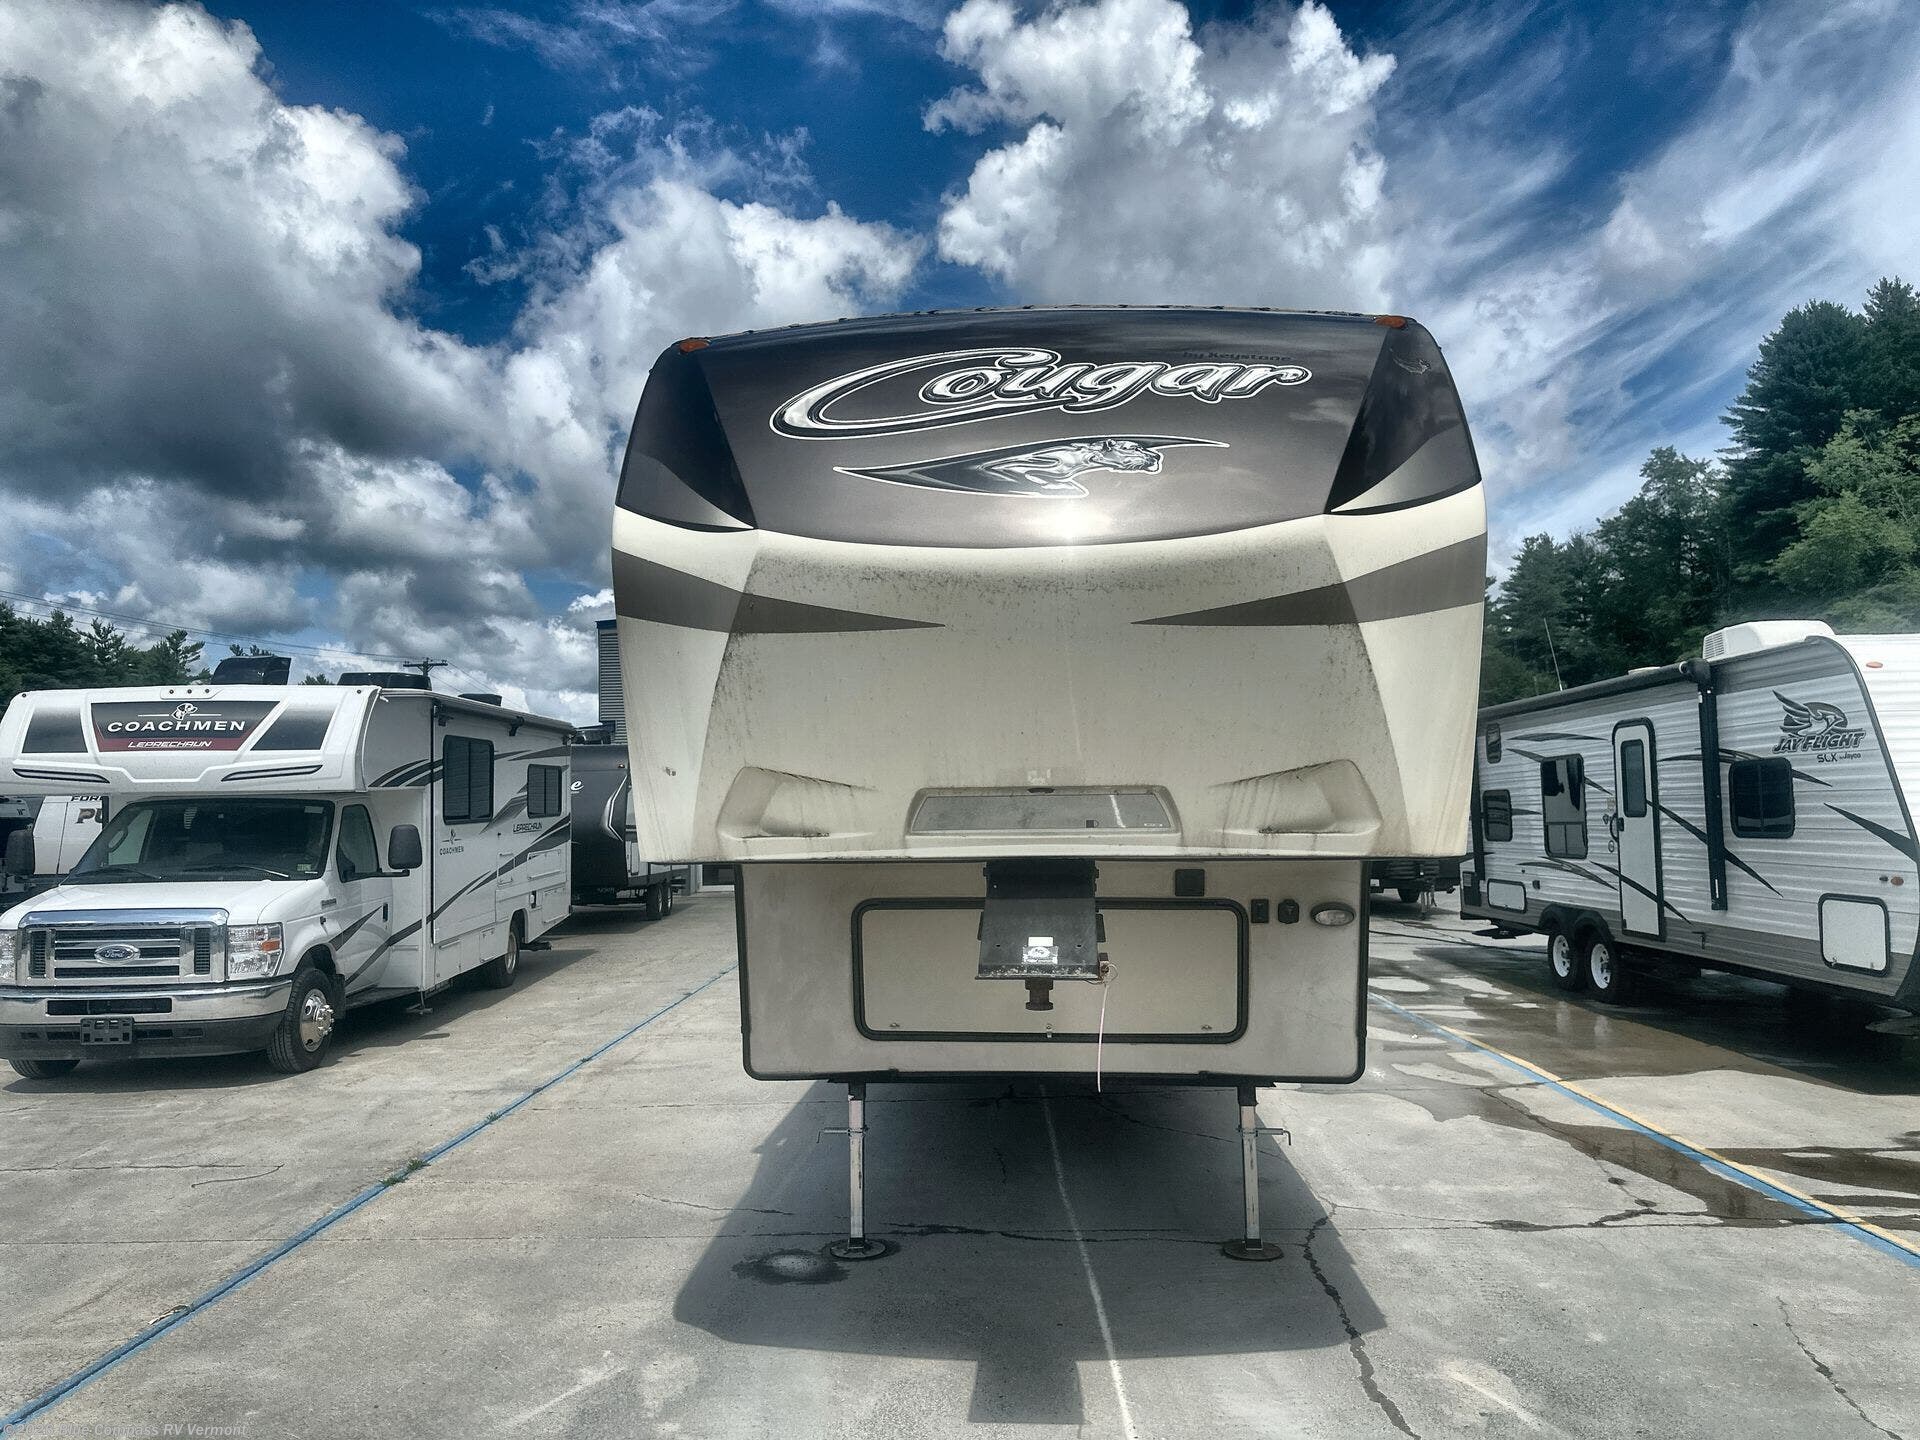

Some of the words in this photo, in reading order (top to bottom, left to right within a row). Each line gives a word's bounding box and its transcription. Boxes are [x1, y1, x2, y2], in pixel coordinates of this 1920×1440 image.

[1183, 351, 1204, 360] by
[1208, 352, 1294, 361] Keystone
[769, 347, 1312, 440] Cougar
[107, 720, 246, 732] COACHMEN
[128, 740, 212, 748] LEPRECHAUN
[1772, 734, 1803, 754] JAY
[1801, 732, 1866, 751] FLIGHT
[1816, 752, 1839, 763] SLX
[439, 846, 464, 855] COACHMEN
